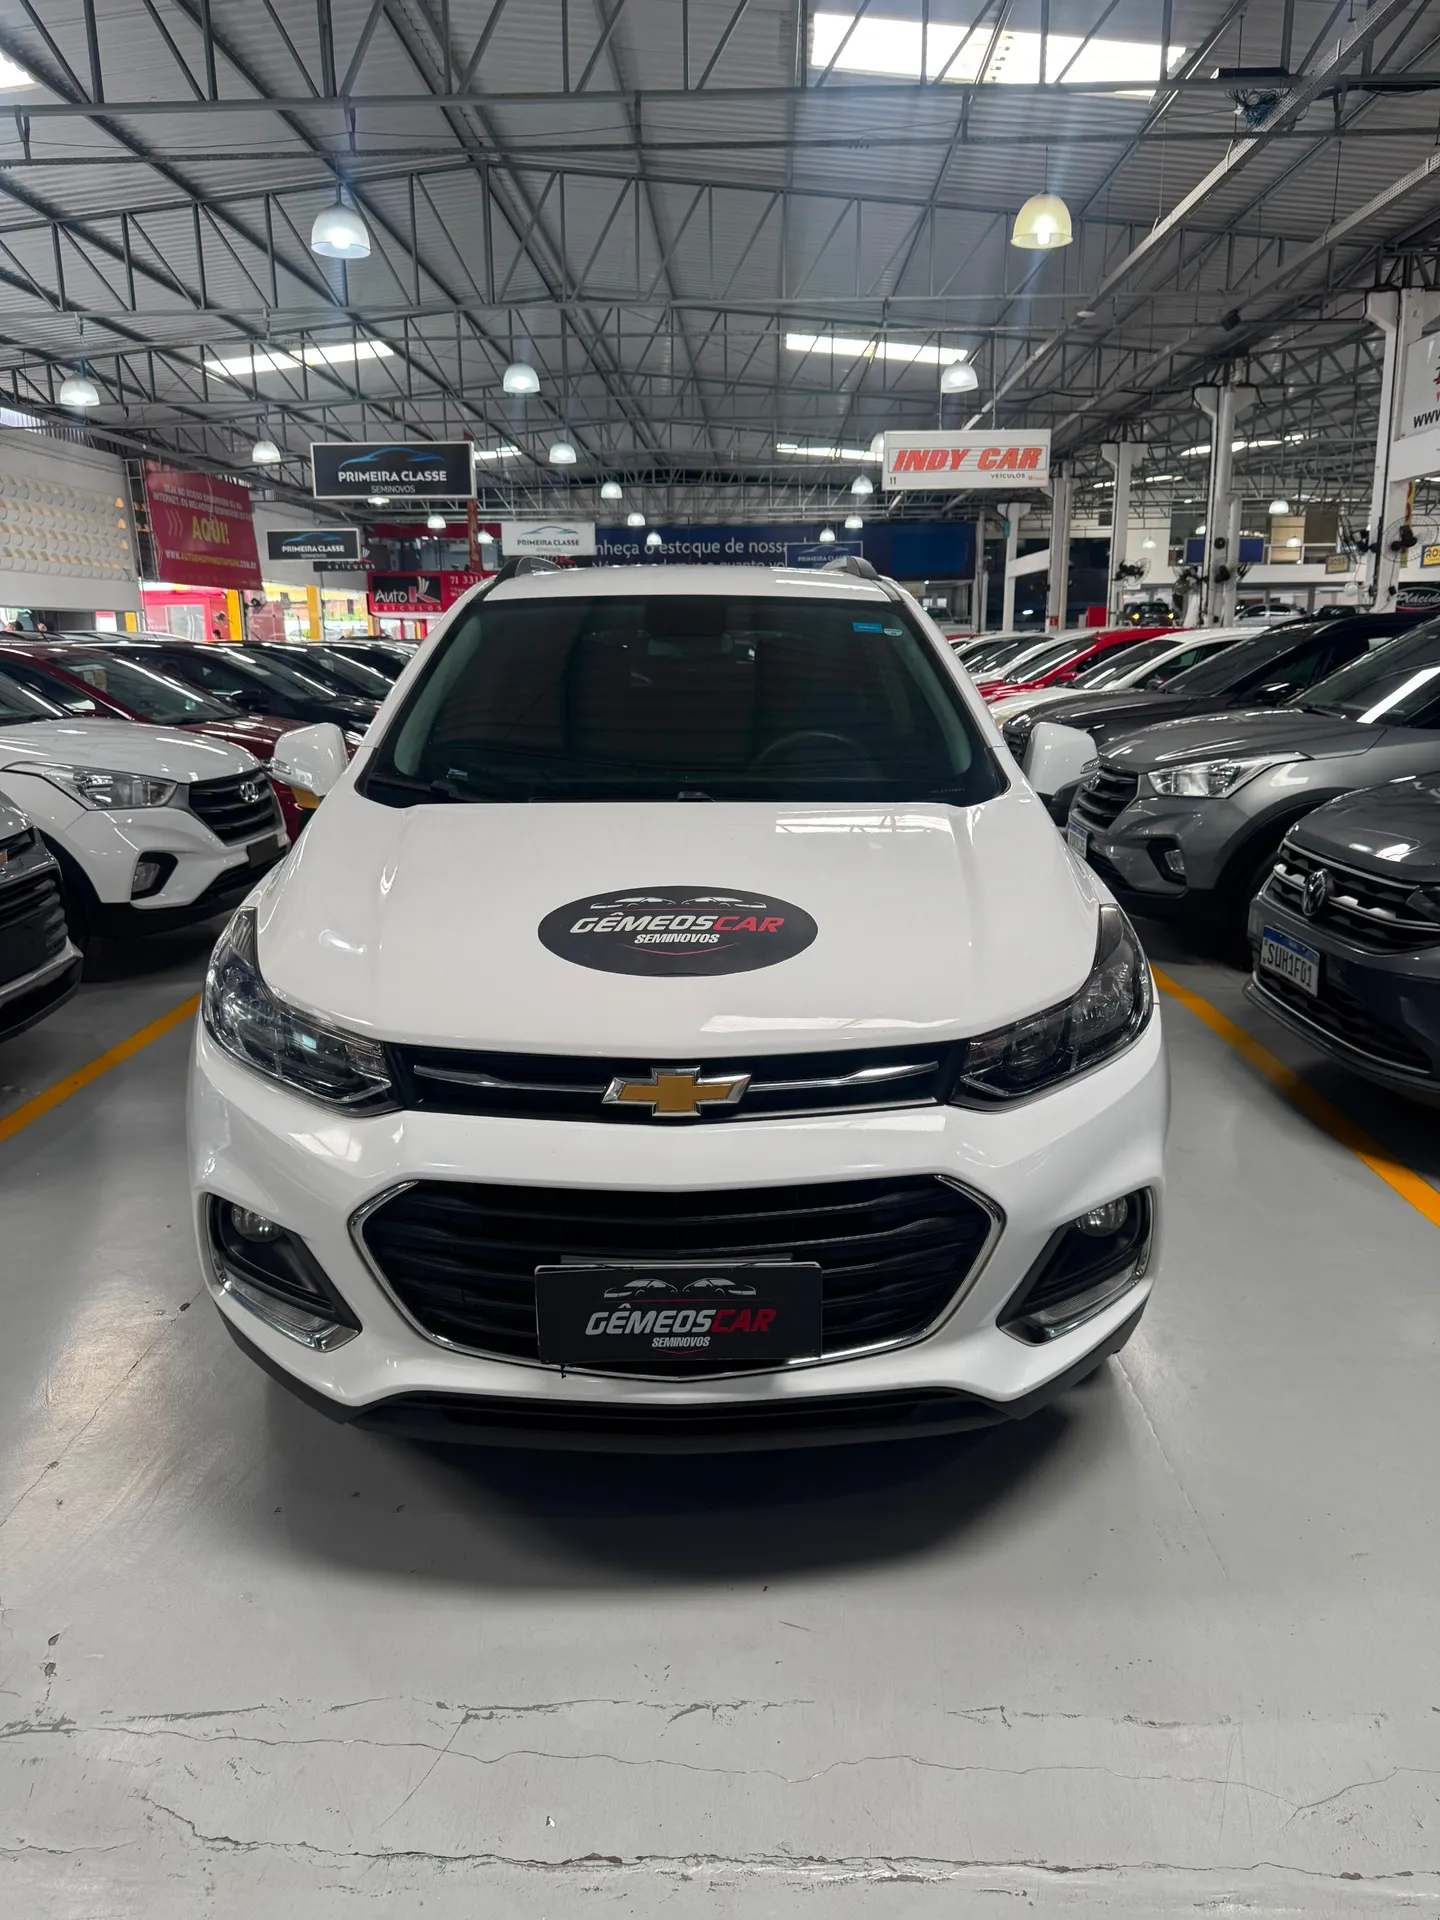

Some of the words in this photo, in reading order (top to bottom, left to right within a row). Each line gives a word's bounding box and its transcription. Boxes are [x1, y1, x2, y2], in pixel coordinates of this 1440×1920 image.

[892, 449, 971, 472] INDY
[977, 447, 1043, 470] CAR
[338, 470, 400, 483] PRIMEIRA
[401, 470, 448, 482] CLASSE
[371, 485, 416, 493] SEMINOVOS
[192, 515, 230, 545] AQUI!
[595, 539, 639, 558] nheça
[659, 540, 720, 557] estoque
[725, 537, 744, 553] de
[749, 541, 786, 553] noss
[449, 576, 459, 585] 71
[375, 589, 408, 603] Auto
[569, 911, 785, 934] GÊMEOSCAR
[634, 933, 720, 944] SEMINOVOS
[585, 1302, 777, 1336] GÊMEOSCAR
[651, 1336, 711, 1347] SEMINOVOS
